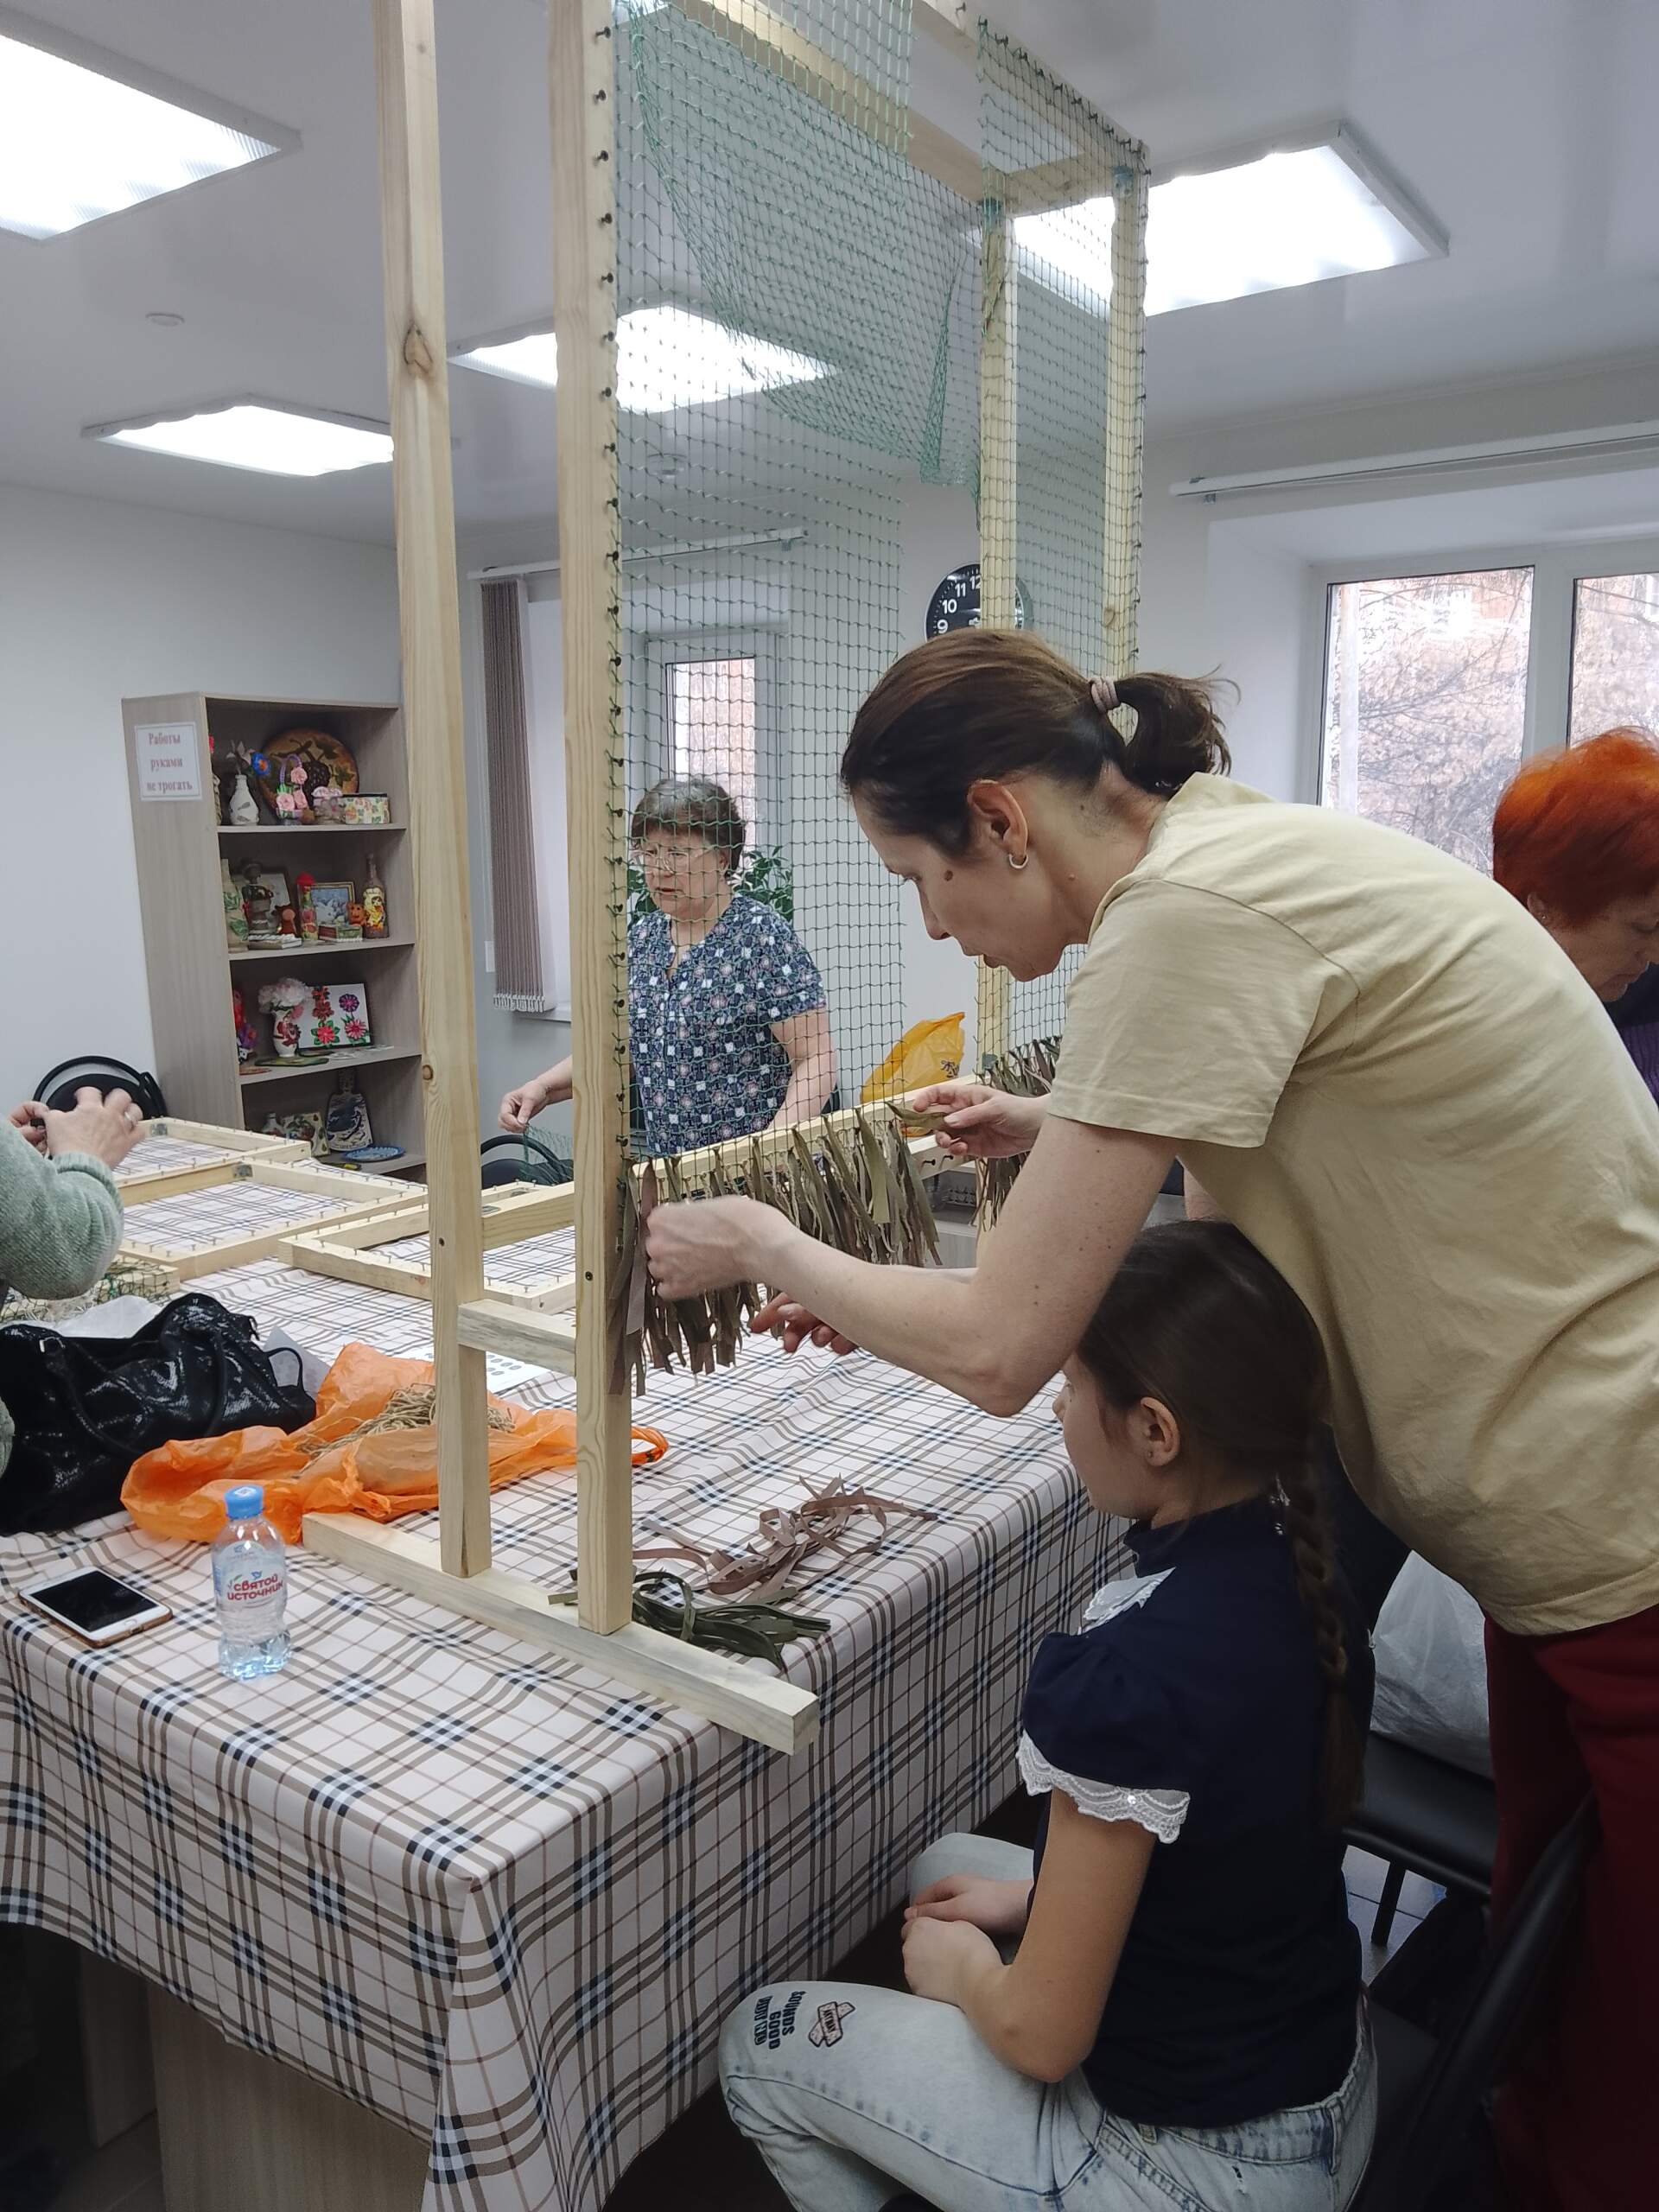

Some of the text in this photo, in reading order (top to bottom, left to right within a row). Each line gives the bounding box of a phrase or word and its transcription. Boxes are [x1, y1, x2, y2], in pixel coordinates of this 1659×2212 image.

[955, 582, 966, 597] 11
[942, 599, 957, 614] 10
[937, 619, 949, 634] 9
[149, 733, 181, 745] Работы
[150, 759, 182, 772] руками
[147, 781, 193, 794] не трогать
[782, 1990, 806, 2036] SOUNDS
[768, 2011, 782, 2050] GOOD
